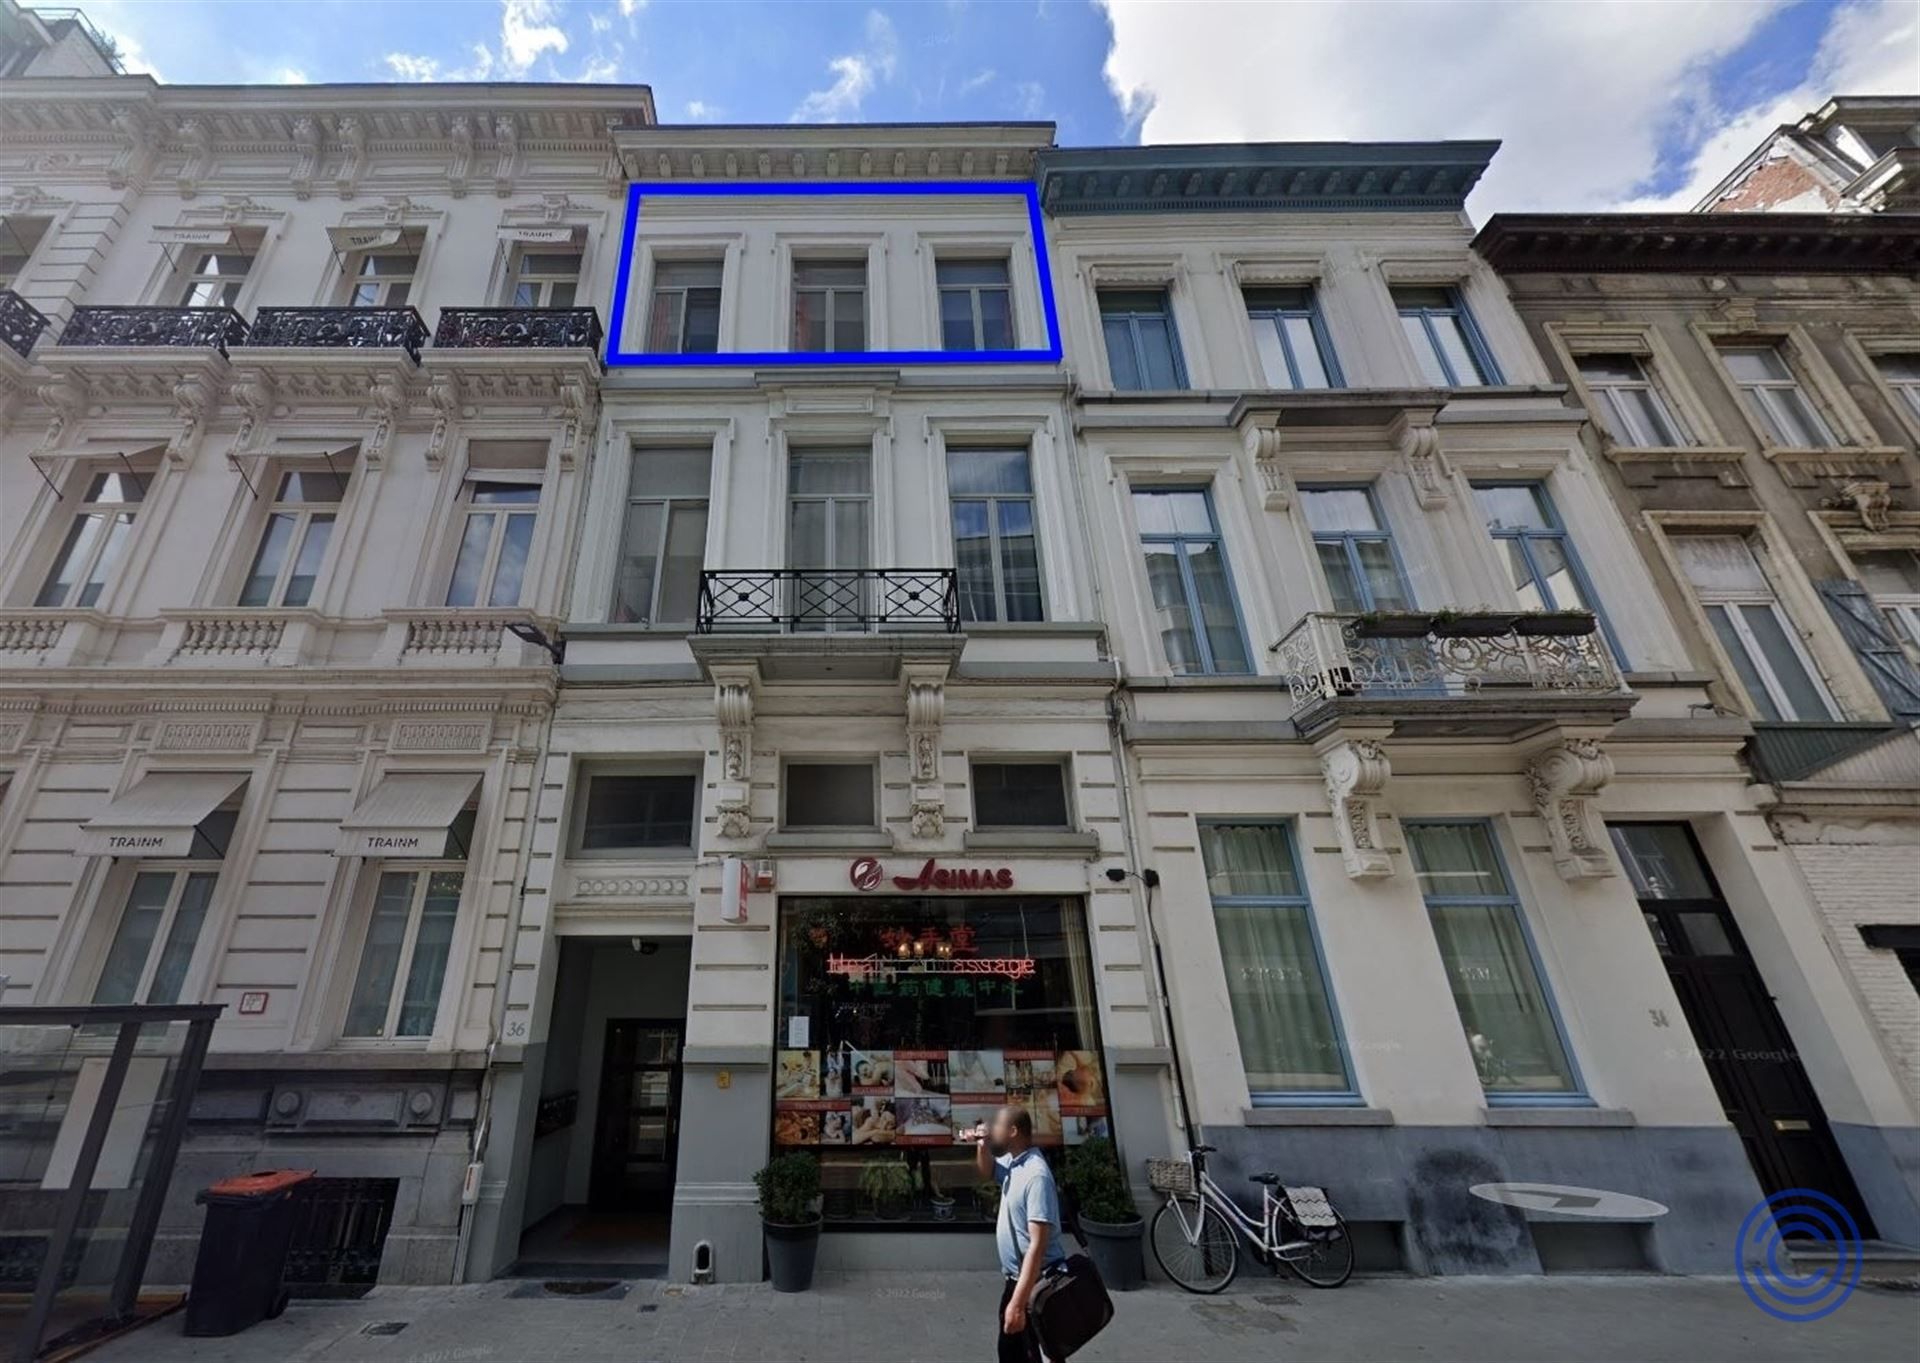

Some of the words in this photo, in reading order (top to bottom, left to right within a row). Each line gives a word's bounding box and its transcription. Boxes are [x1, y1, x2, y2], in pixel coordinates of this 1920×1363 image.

[110, 836, 164, 848] TRAINM
[367, 837, 419, 848] TRAINM
[506, 1021, 526, 1037] 36
